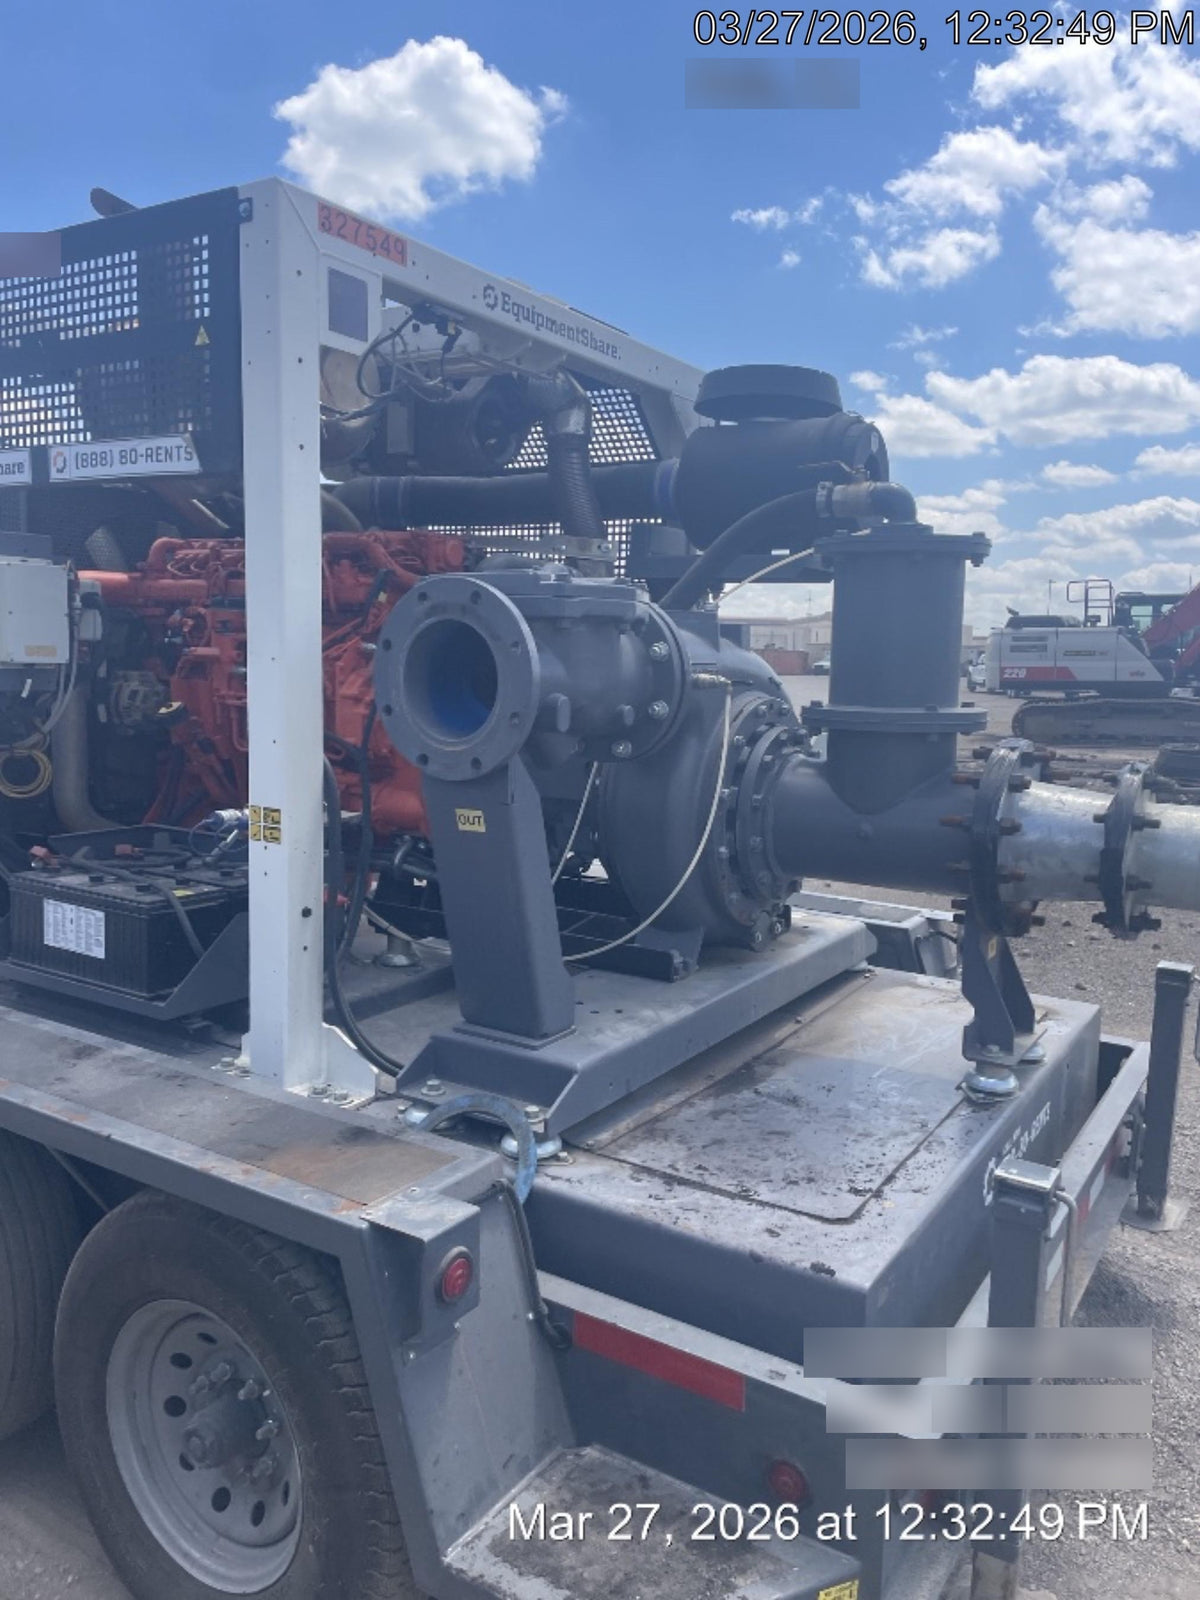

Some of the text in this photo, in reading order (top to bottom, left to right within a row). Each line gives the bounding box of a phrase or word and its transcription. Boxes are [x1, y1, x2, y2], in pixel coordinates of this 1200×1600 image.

[320, 204, 405, 265] 327549
[75, 450, 114, 470] (888)
[458, 813, 483, 827] OUT
